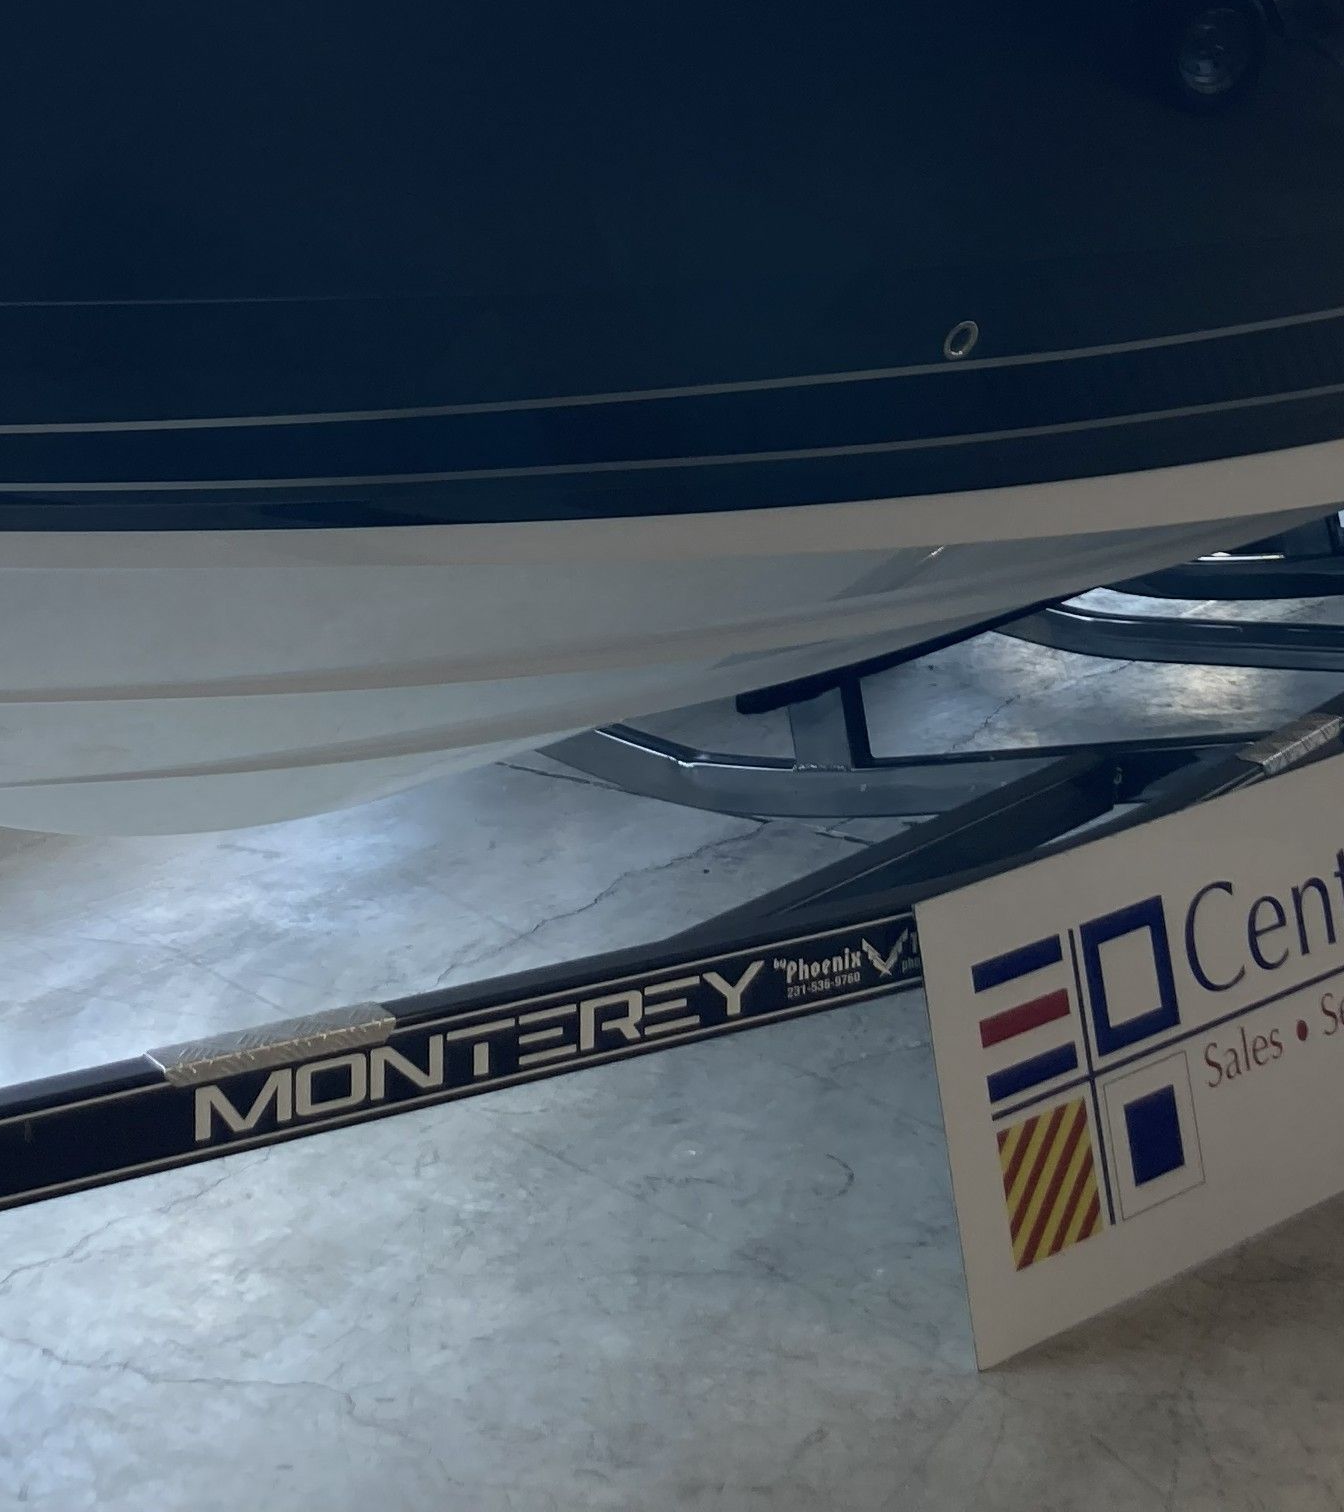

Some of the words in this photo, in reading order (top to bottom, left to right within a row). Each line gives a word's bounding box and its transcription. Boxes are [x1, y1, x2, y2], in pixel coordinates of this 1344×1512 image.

[786, 947, 862, 984] Phoenix
[194, 959, 765, 1143] MONTEREY
[1203, 1025, 1285, 1089] Sales
